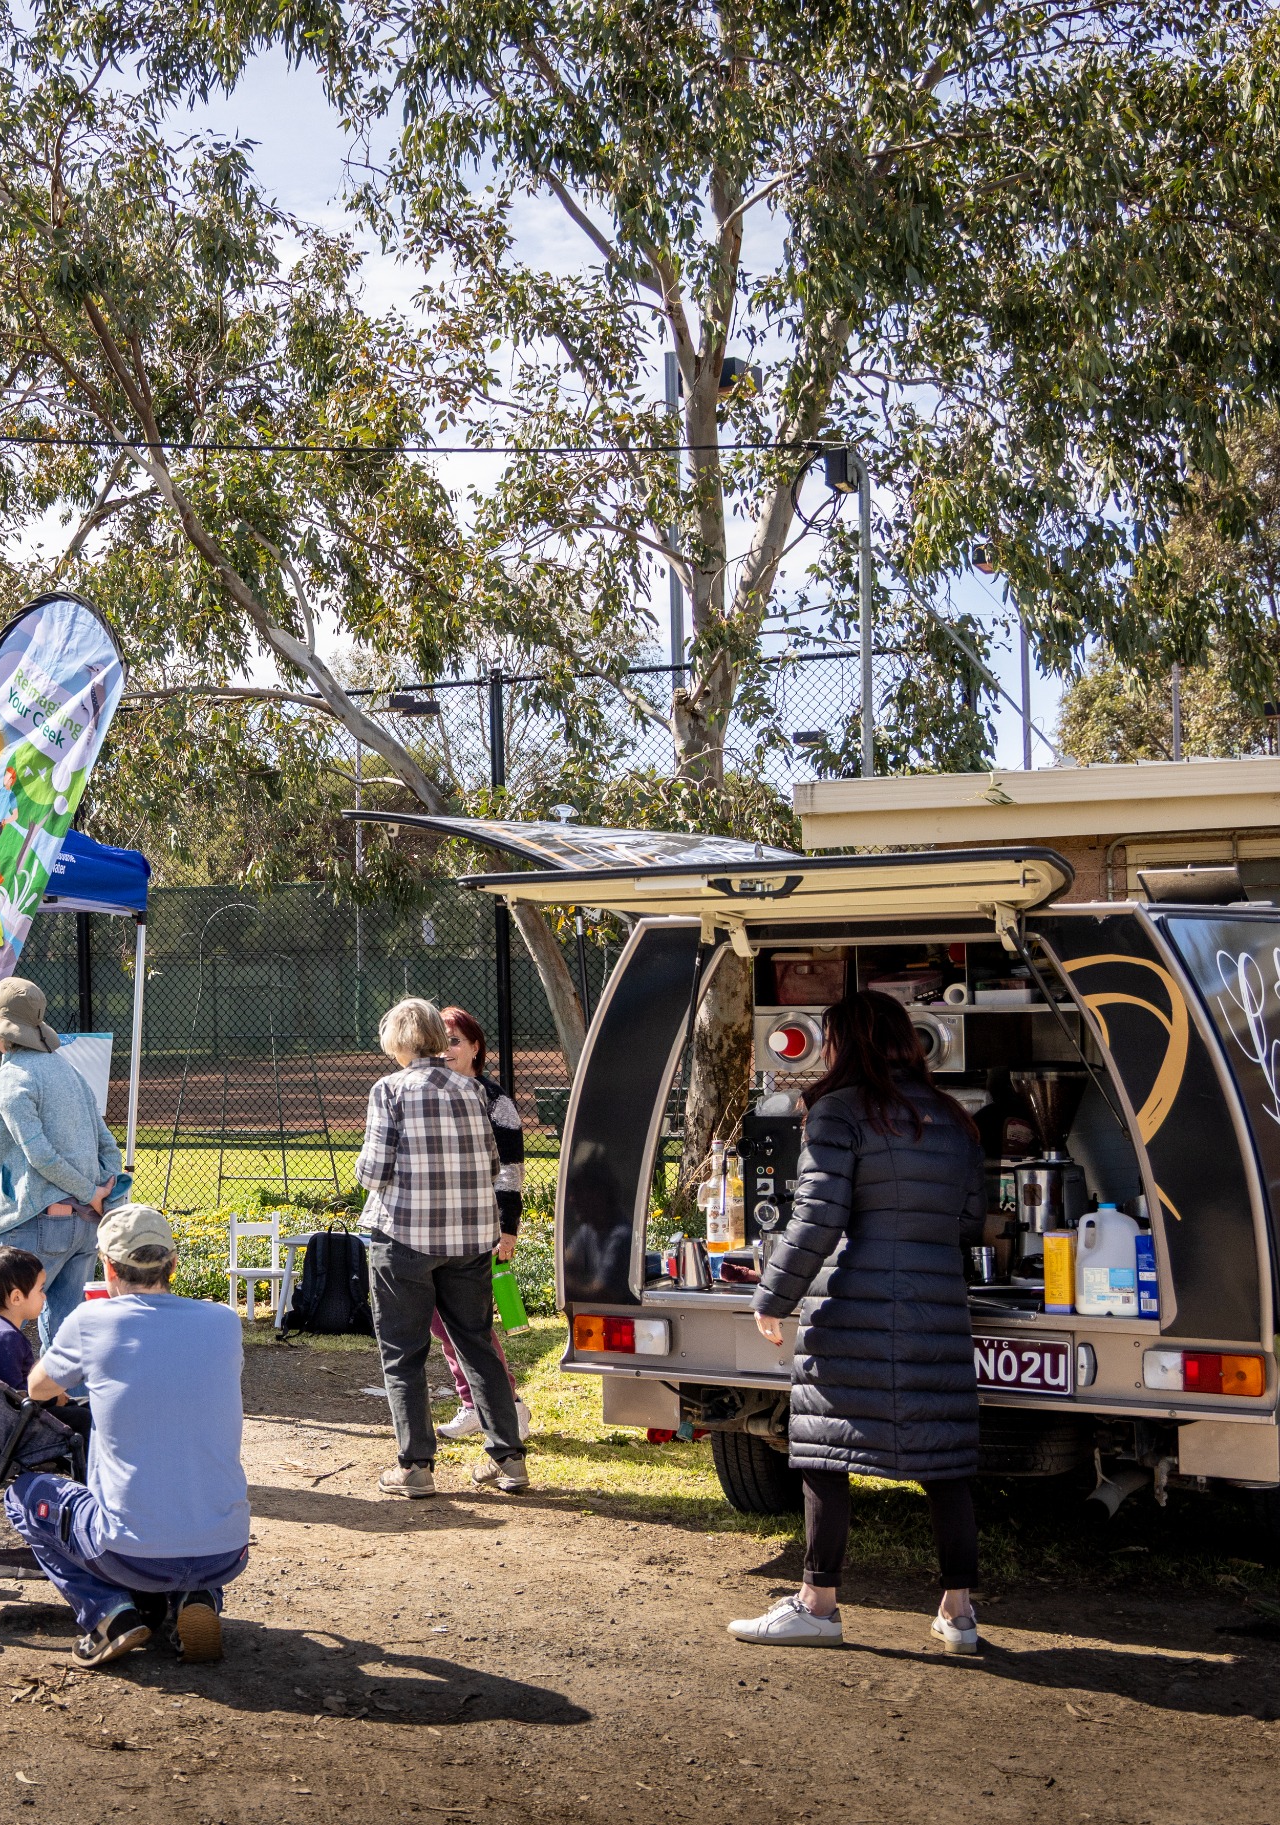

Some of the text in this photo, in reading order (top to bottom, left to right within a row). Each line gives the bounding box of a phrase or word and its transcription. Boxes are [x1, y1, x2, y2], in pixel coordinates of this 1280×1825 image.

[8, 687, 65, 749] Your Creek
[983, 1340, 1009, 1349] VIC
